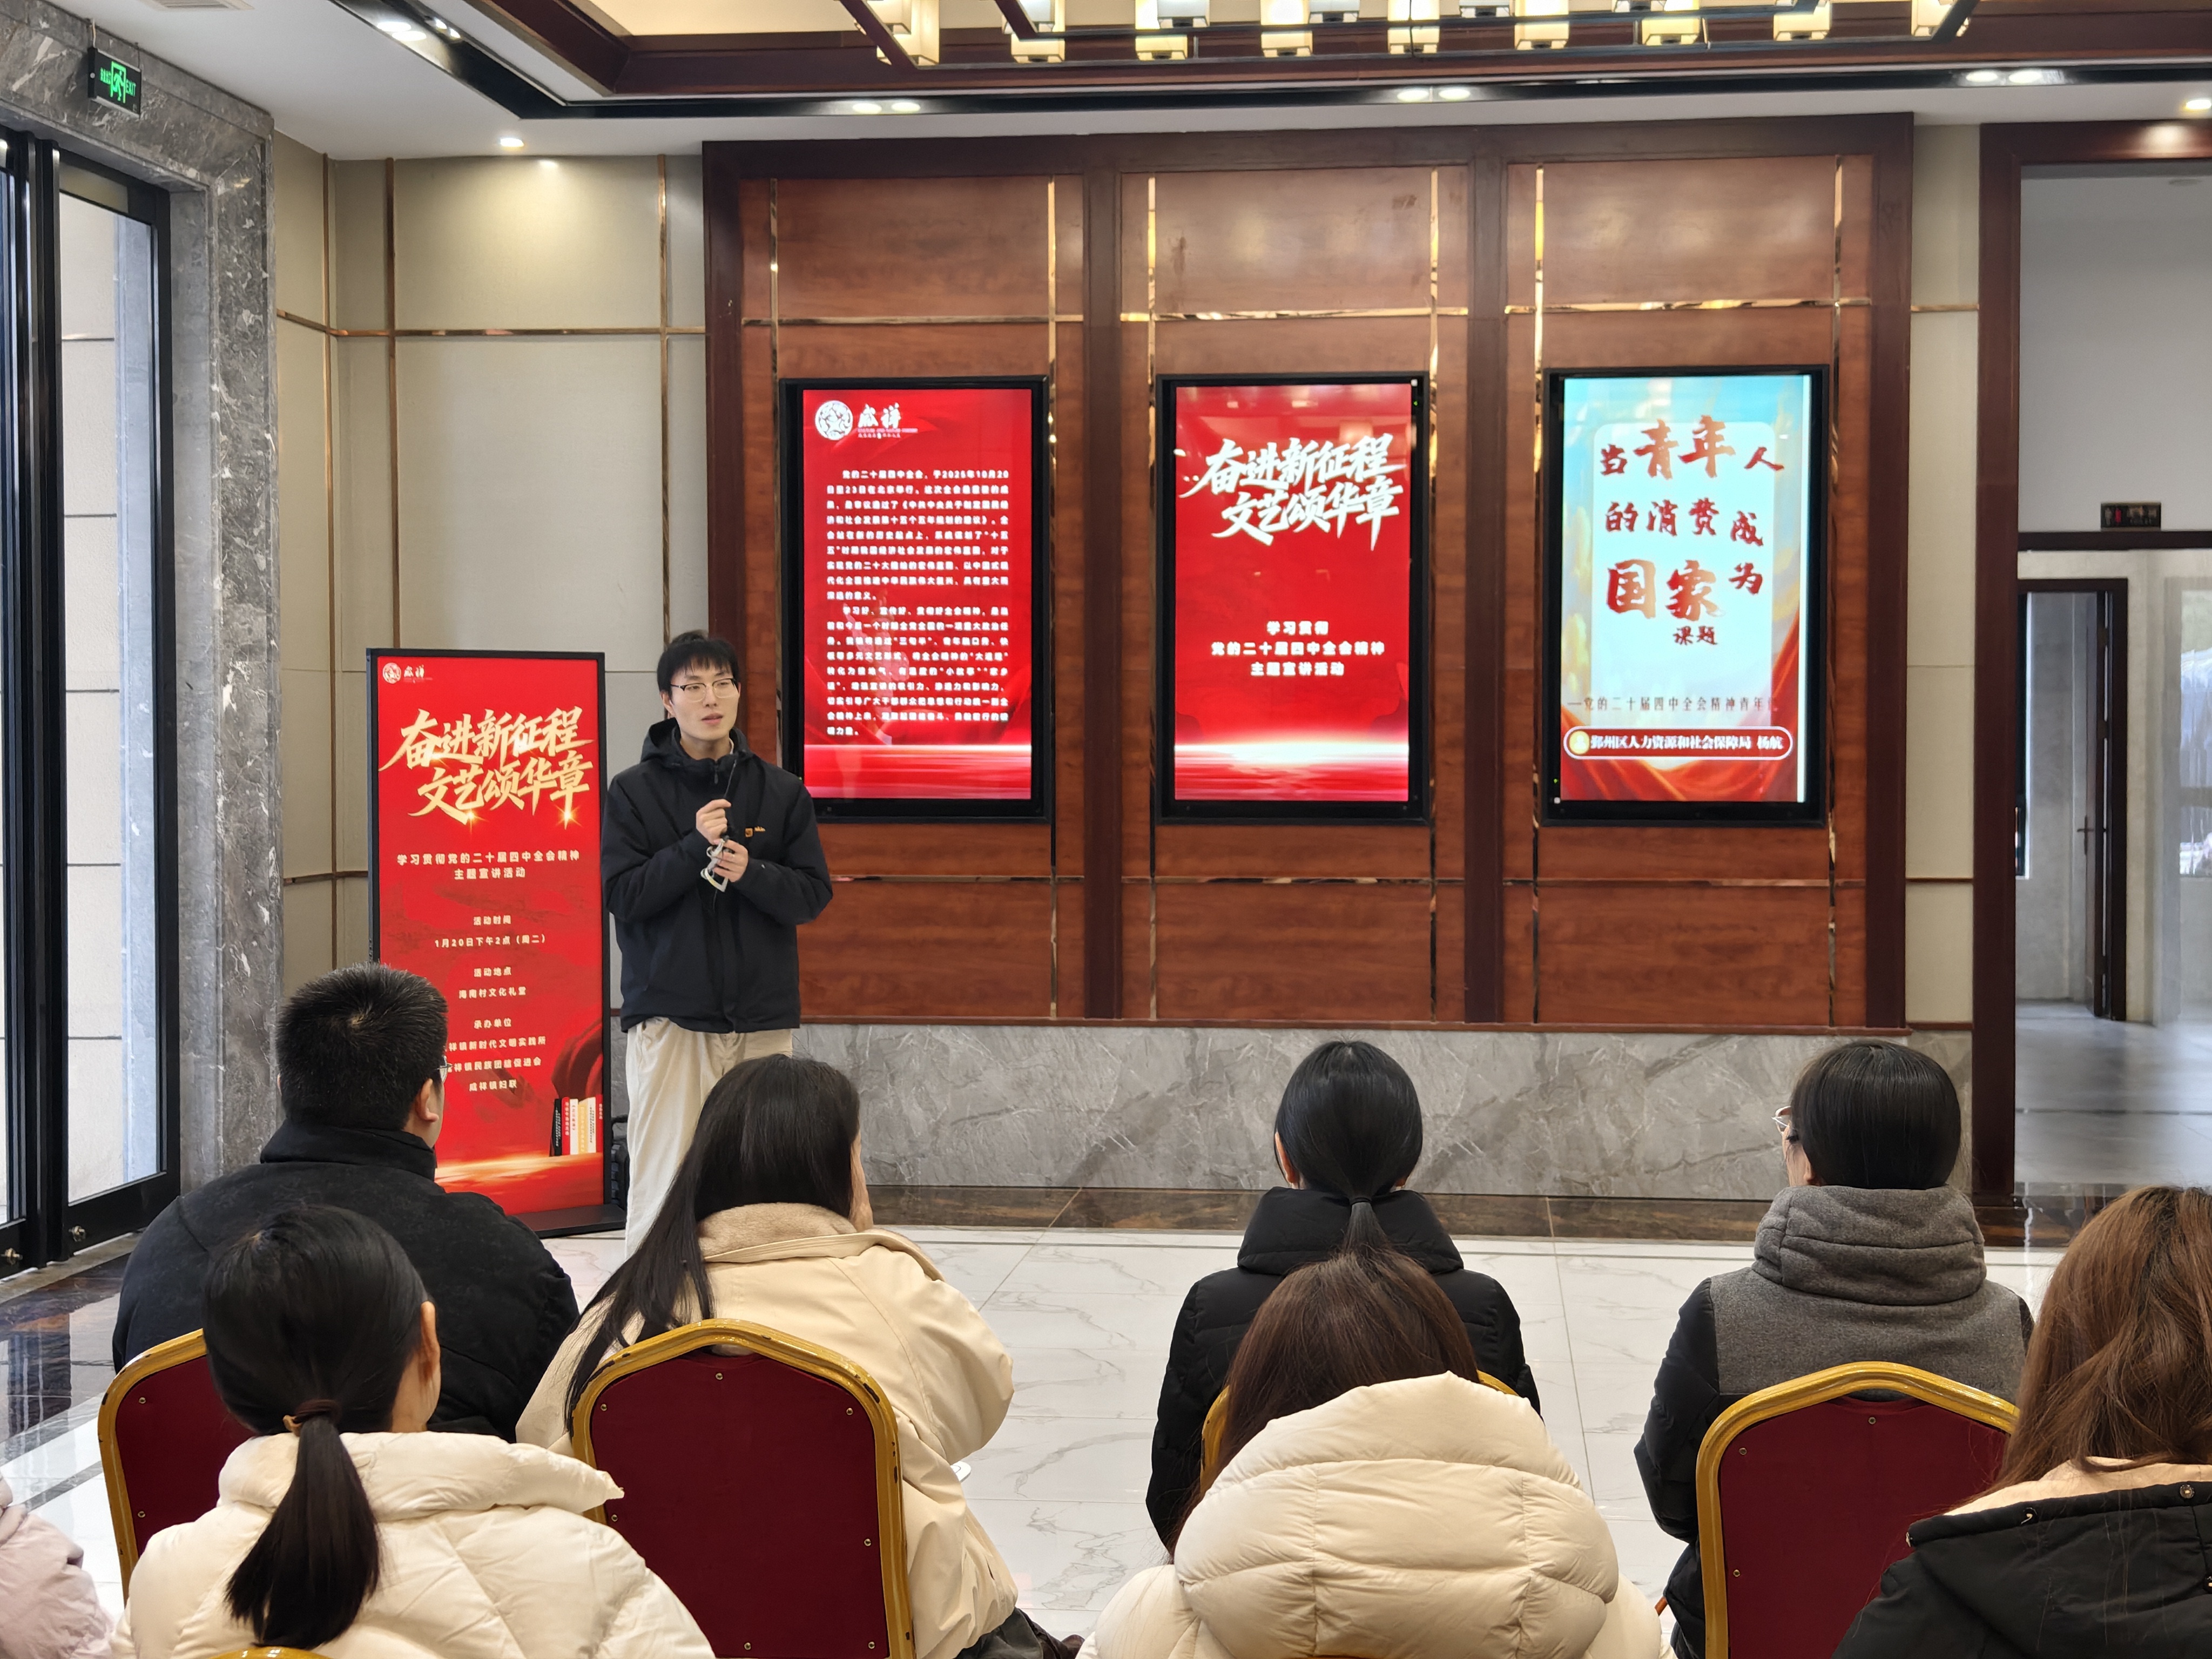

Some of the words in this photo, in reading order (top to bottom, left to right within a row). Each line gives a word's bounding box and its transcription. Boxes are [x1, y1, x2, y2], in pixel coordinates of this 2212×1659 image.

[126, 79, 136, 97] EXIT
[1601, 415, 1785, 480] 当青年人
[1179, 433, 1407, 498] 奋进新征程
[1211, 476, 1405, 551] 文艺颂华章
[1607, 559, 1725, 622] 国家
[1266, 621, 1329, 635] 学习贯彻
[1673, 626, 1717, 645] 课题
[1211, 640, 1385, 656] 党的二十届四中全会精神
[1250, 661, 1345, 676] 主题宣讲活动
[379, 706, 595, 771] 奋进新征程
[1589, 734, 1751, 750] 鄞州区人力资源和社会保障局
[408, 750, 594, 828] 文艺颂华章
[397, 849, 579, 866] 学习贯彻党的二十届四中全会精神
[454, 866, 525, 880] 主题宣讲活动
[473, 915, 511, 926] 活动时间
[434, 934, 545, 948] 1月20日下午2点（周二）
[474, 966, 512, 977] 活动地点
[474, 1017, 511, 1029] 承办单位
[446, 1036, 546, 1052] 祥镇新时代文明实践所
